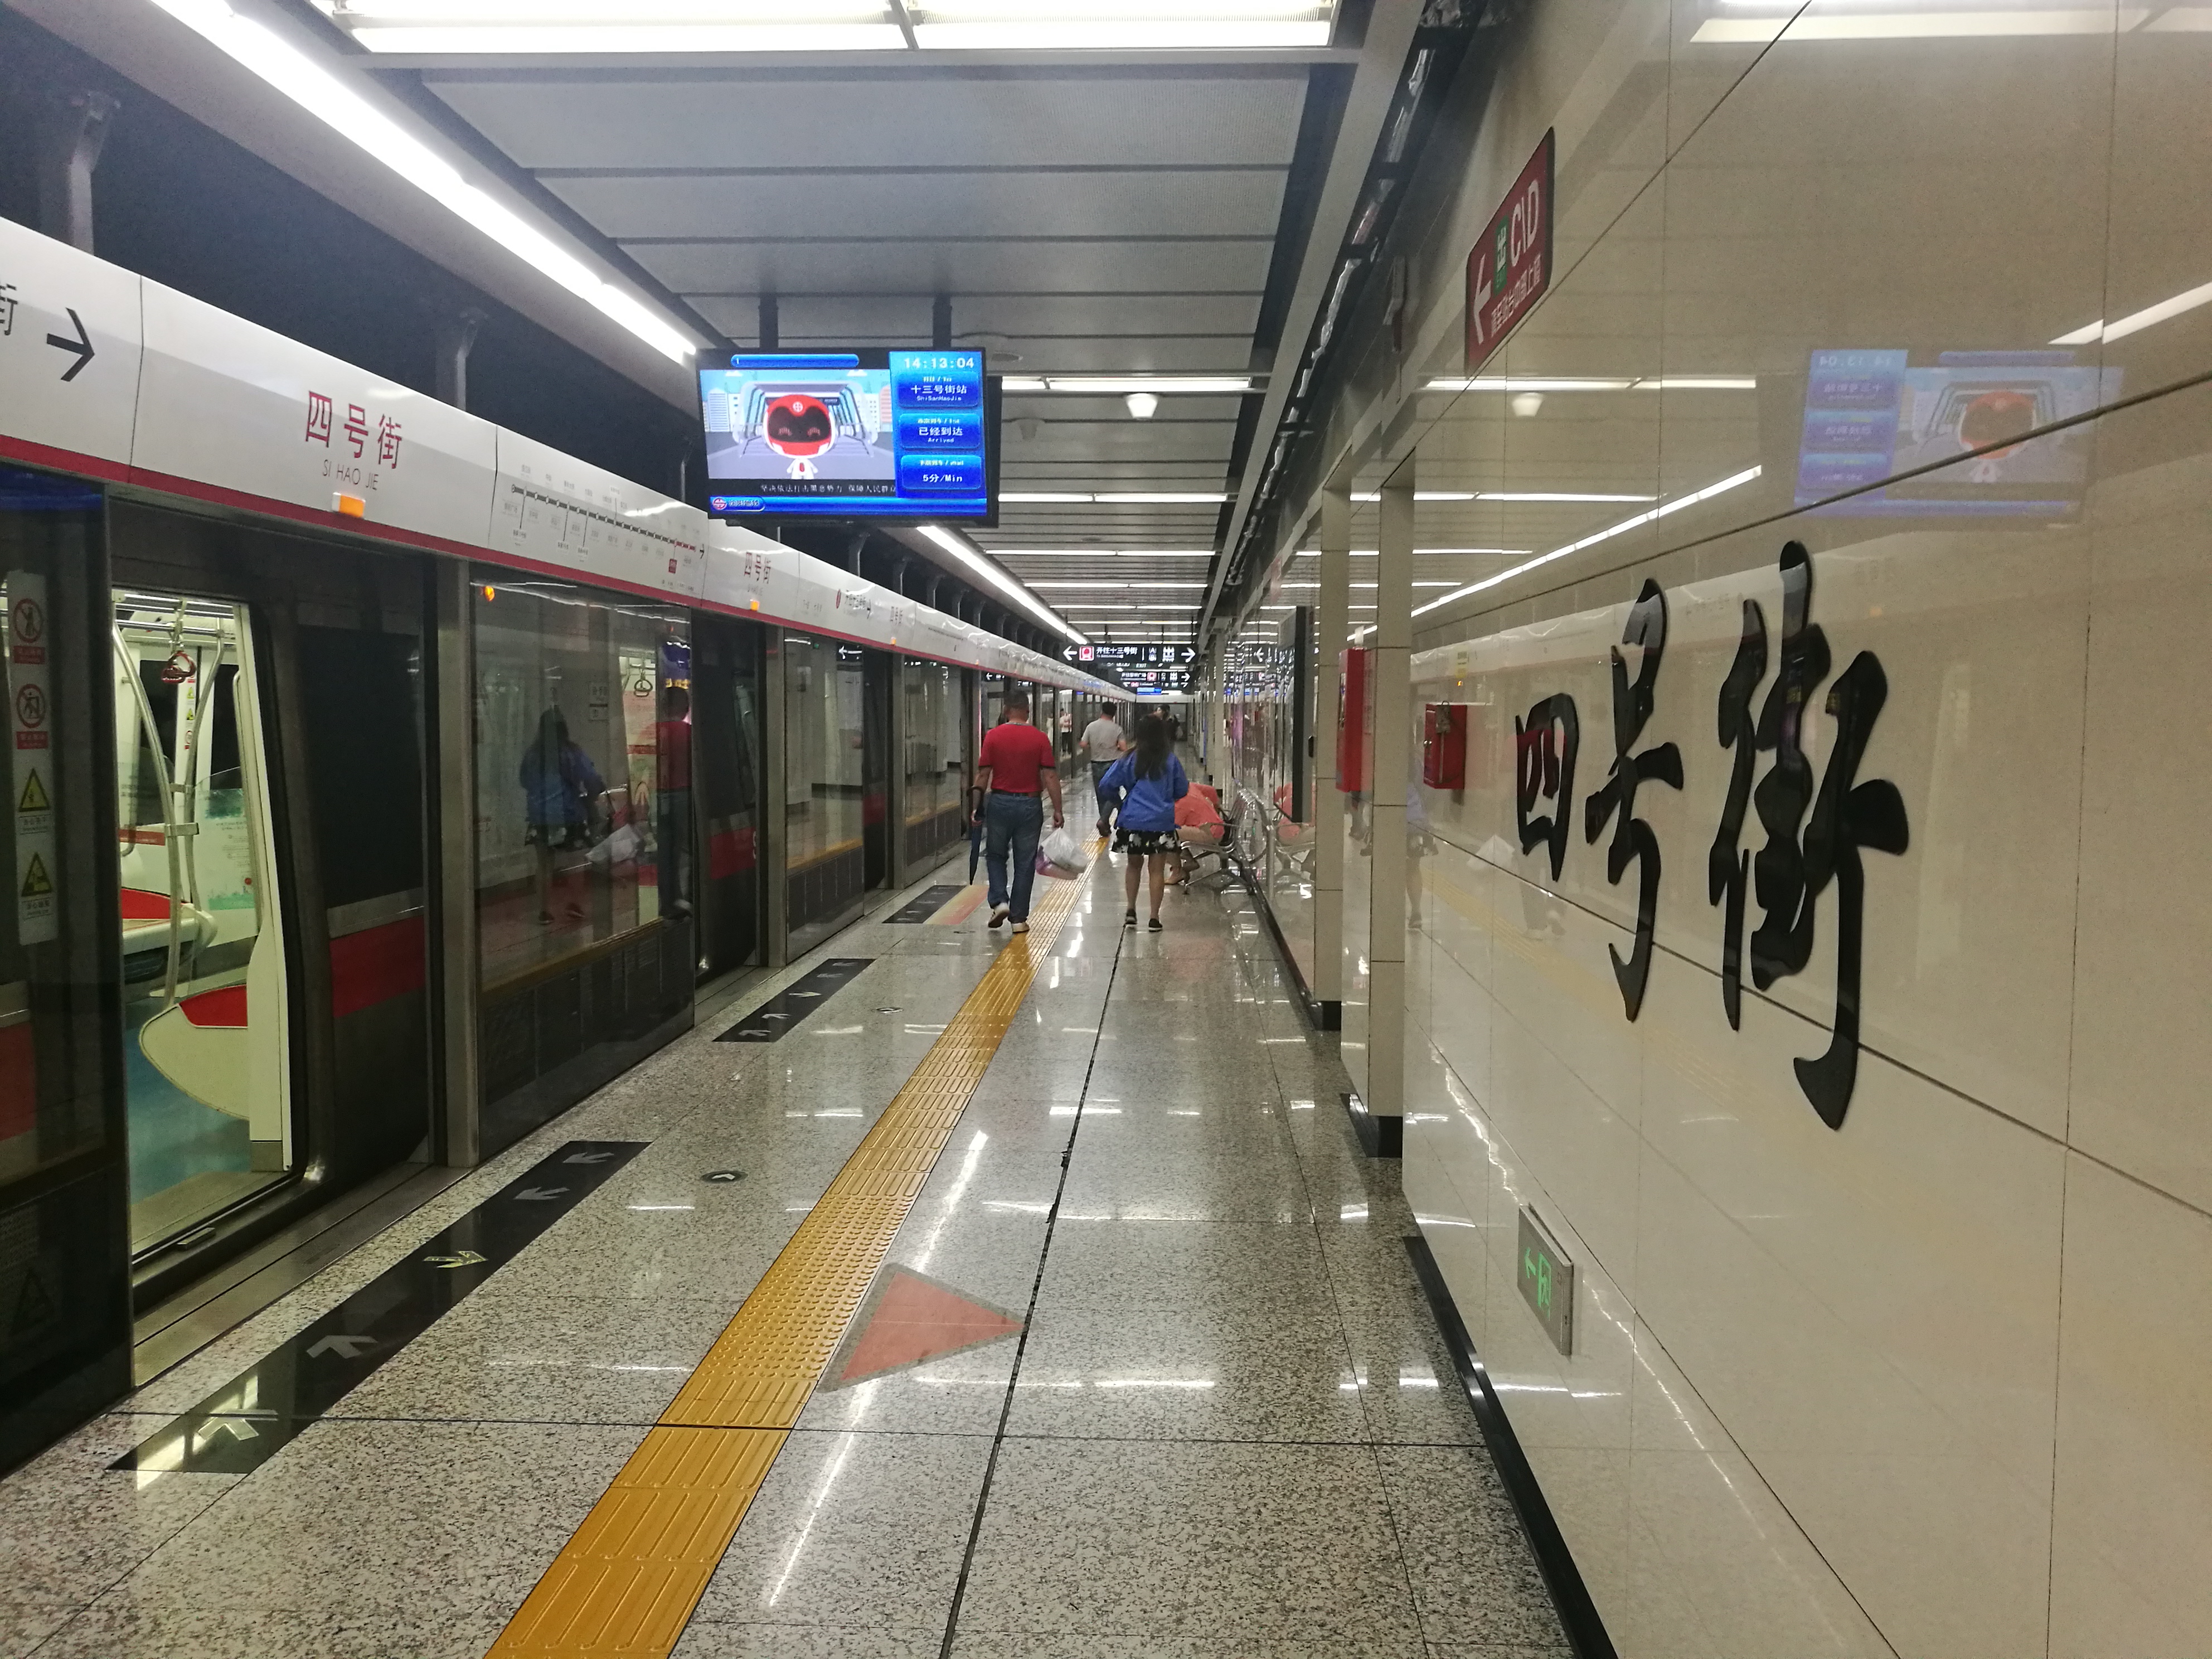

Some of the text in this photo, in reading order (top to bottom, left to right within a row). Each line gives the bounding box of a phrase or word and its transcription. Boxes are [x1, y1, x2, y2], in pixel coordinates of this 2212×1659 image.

[904, 357, 974, 368] 14:13:04
[911, 385, 967, 394] 十三号街站
[305, 391, 402, 469] 四号街
[919, 426, 964, 436] 已经到达
[322, 459, 379, 491] SI HAO JIE
[1515, 540, 1909, 1131] 四号街
